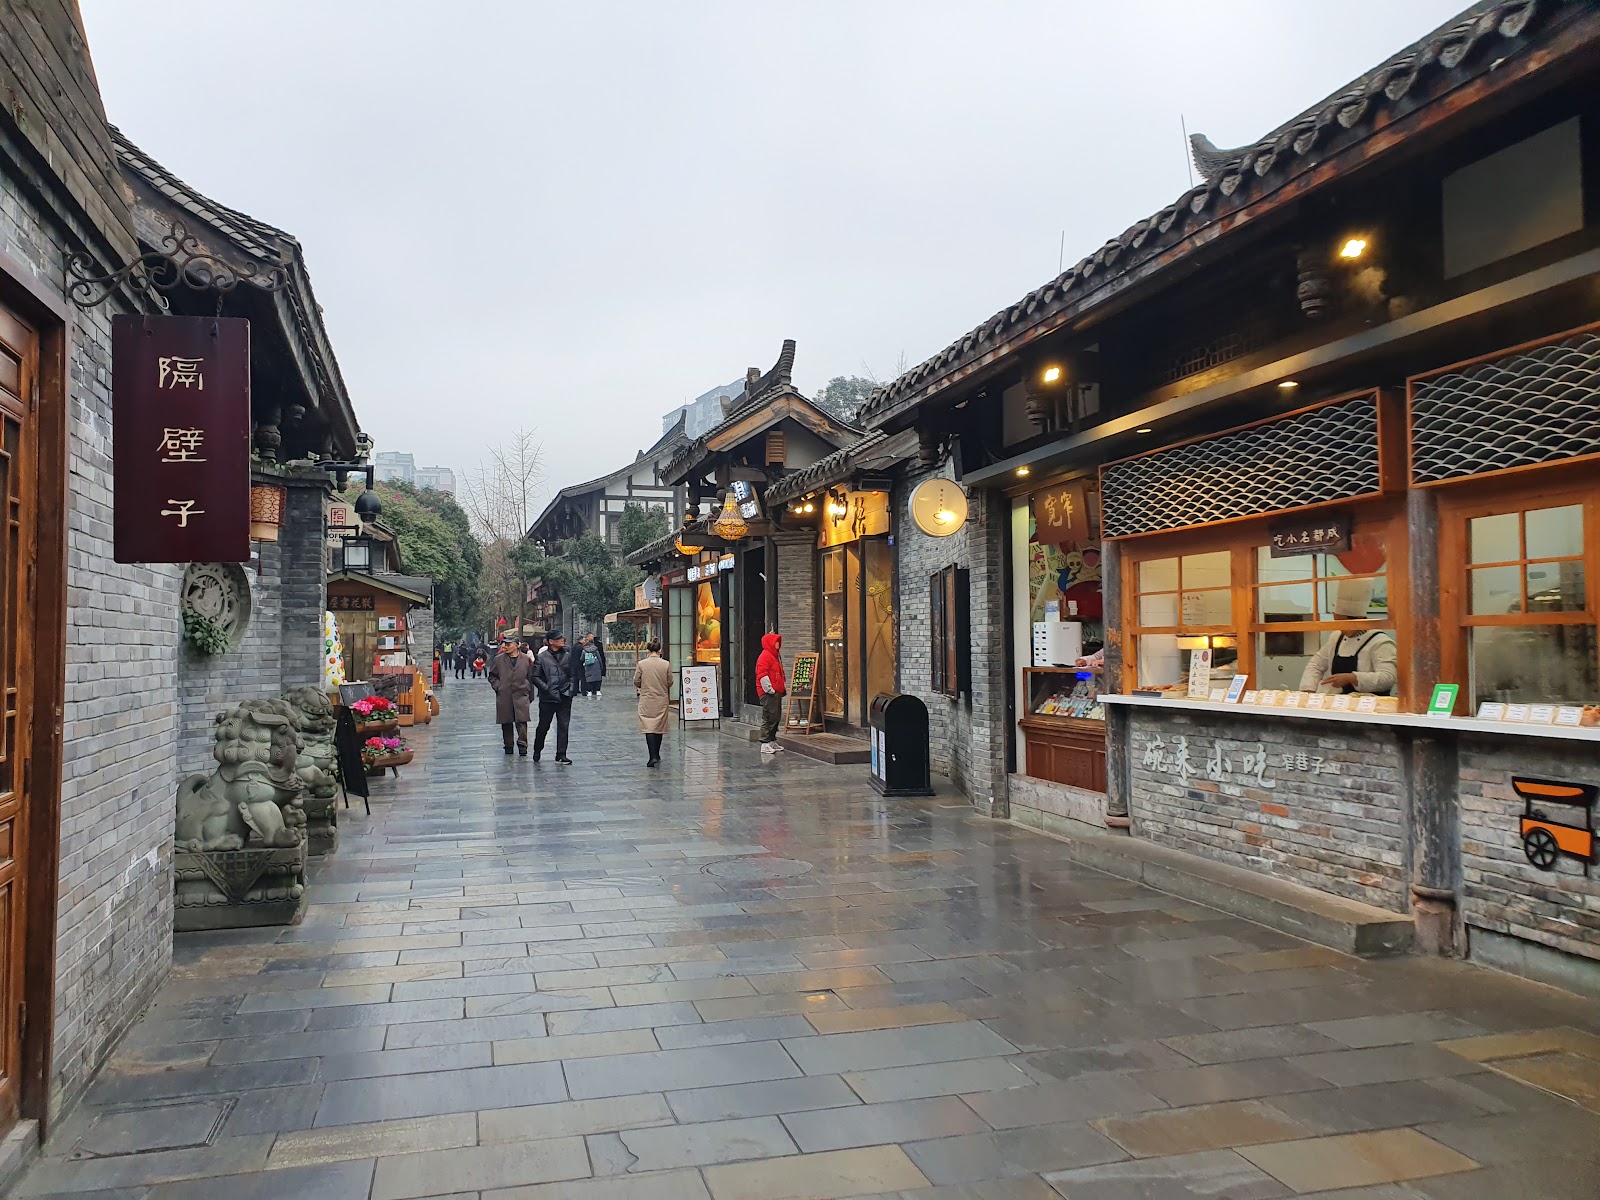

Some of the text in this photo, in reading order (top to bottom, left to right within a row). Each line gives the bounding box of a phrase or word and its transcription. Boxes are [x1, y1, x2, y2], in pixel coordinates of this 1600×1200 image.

[156, 355, 208, 528] 隔壁子
[1273, 526, 1340, 547] 成都名小吃
